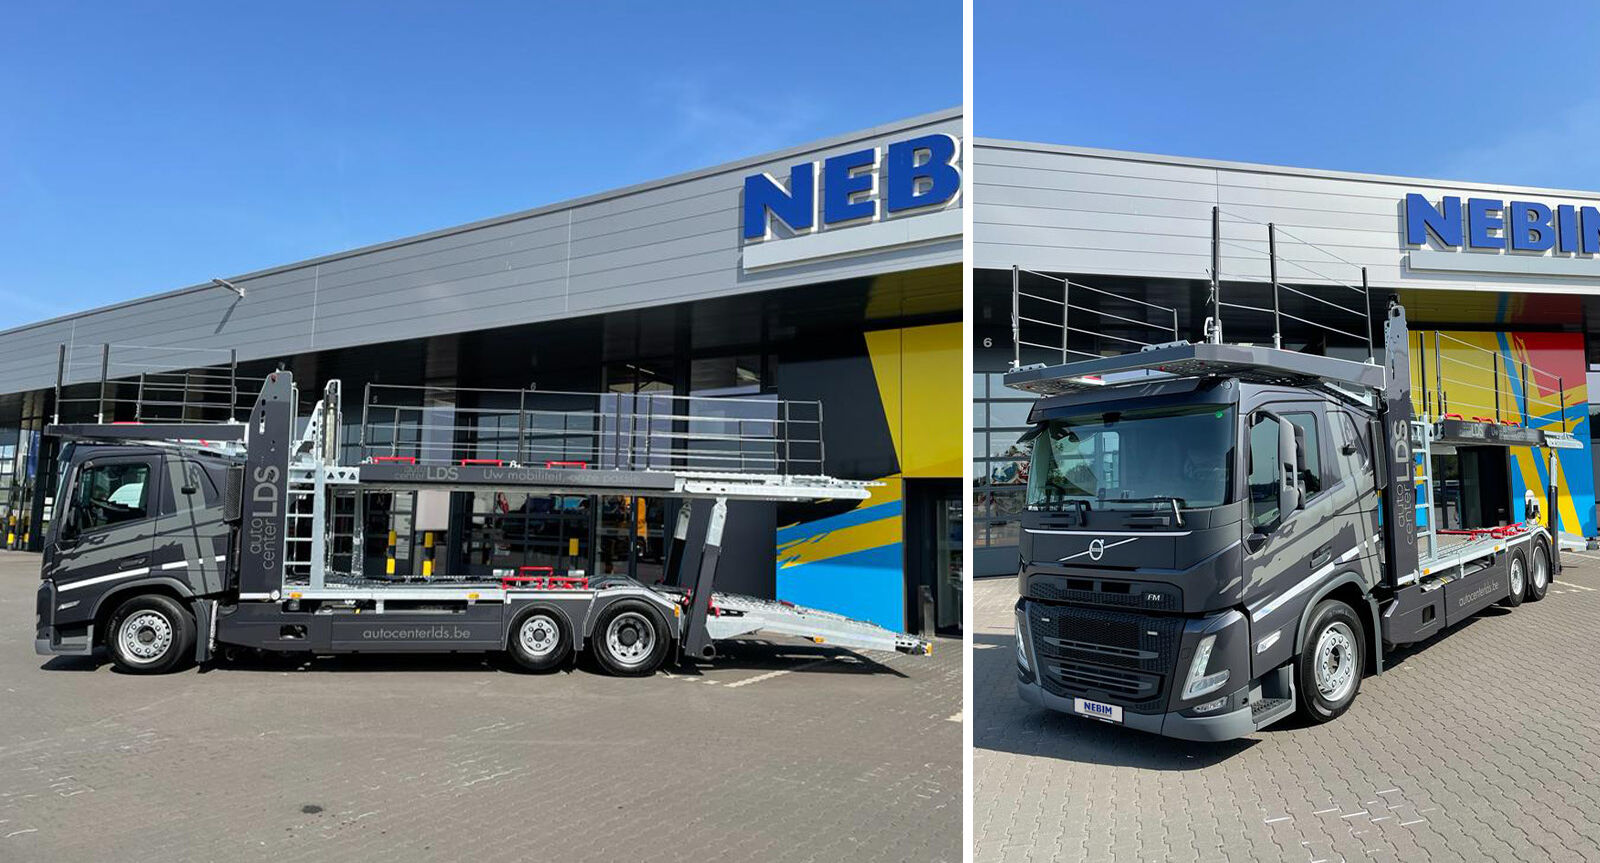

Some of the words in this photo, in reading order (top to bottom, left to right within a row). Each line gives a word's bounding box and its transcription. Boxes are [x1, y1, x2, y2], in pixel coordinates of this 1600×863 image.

[983, 337, 993, 348] 6
[1393, 419, 1410, 482] LDS
[252, 465, 280, 517] LDS
[427, 466, 459, 481] LDS
[483, 469, 503, 480] Uw
[1396, 483, 1406, 528] auto
[1404, 484, 1413, 545] center
[249, 518, 263, 554] auto
[263, 519, 277, 570] center
[362, 625, 471, 639] autocenterlds.be
[1083, 701, 1112, 715] NEBIM
